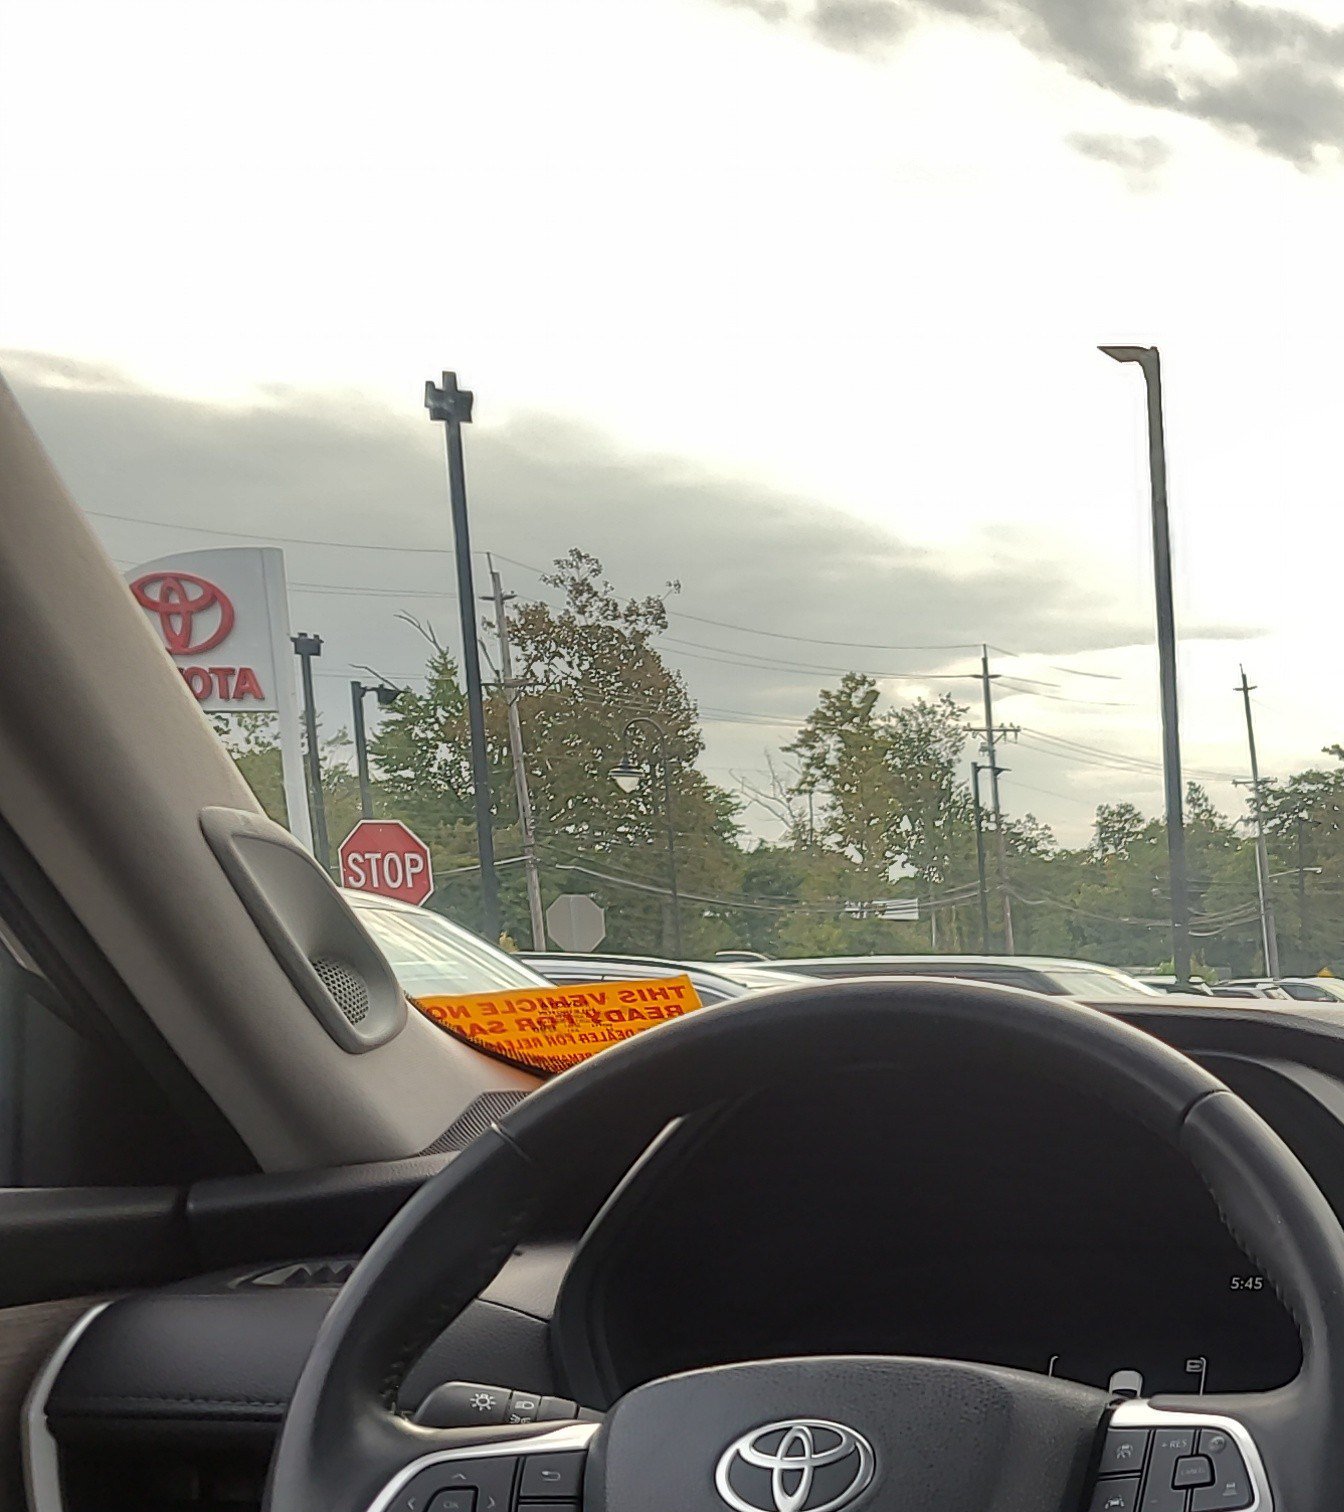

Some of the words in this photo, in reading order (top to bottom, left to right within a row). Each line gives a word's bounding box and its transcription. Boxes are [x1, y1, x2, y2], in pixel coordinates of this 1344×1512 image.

[181, 666, 265, 700] OTA
[347, 852, 424, 889] STOP
[1230, 1277, 1263, 1290] 5:45
